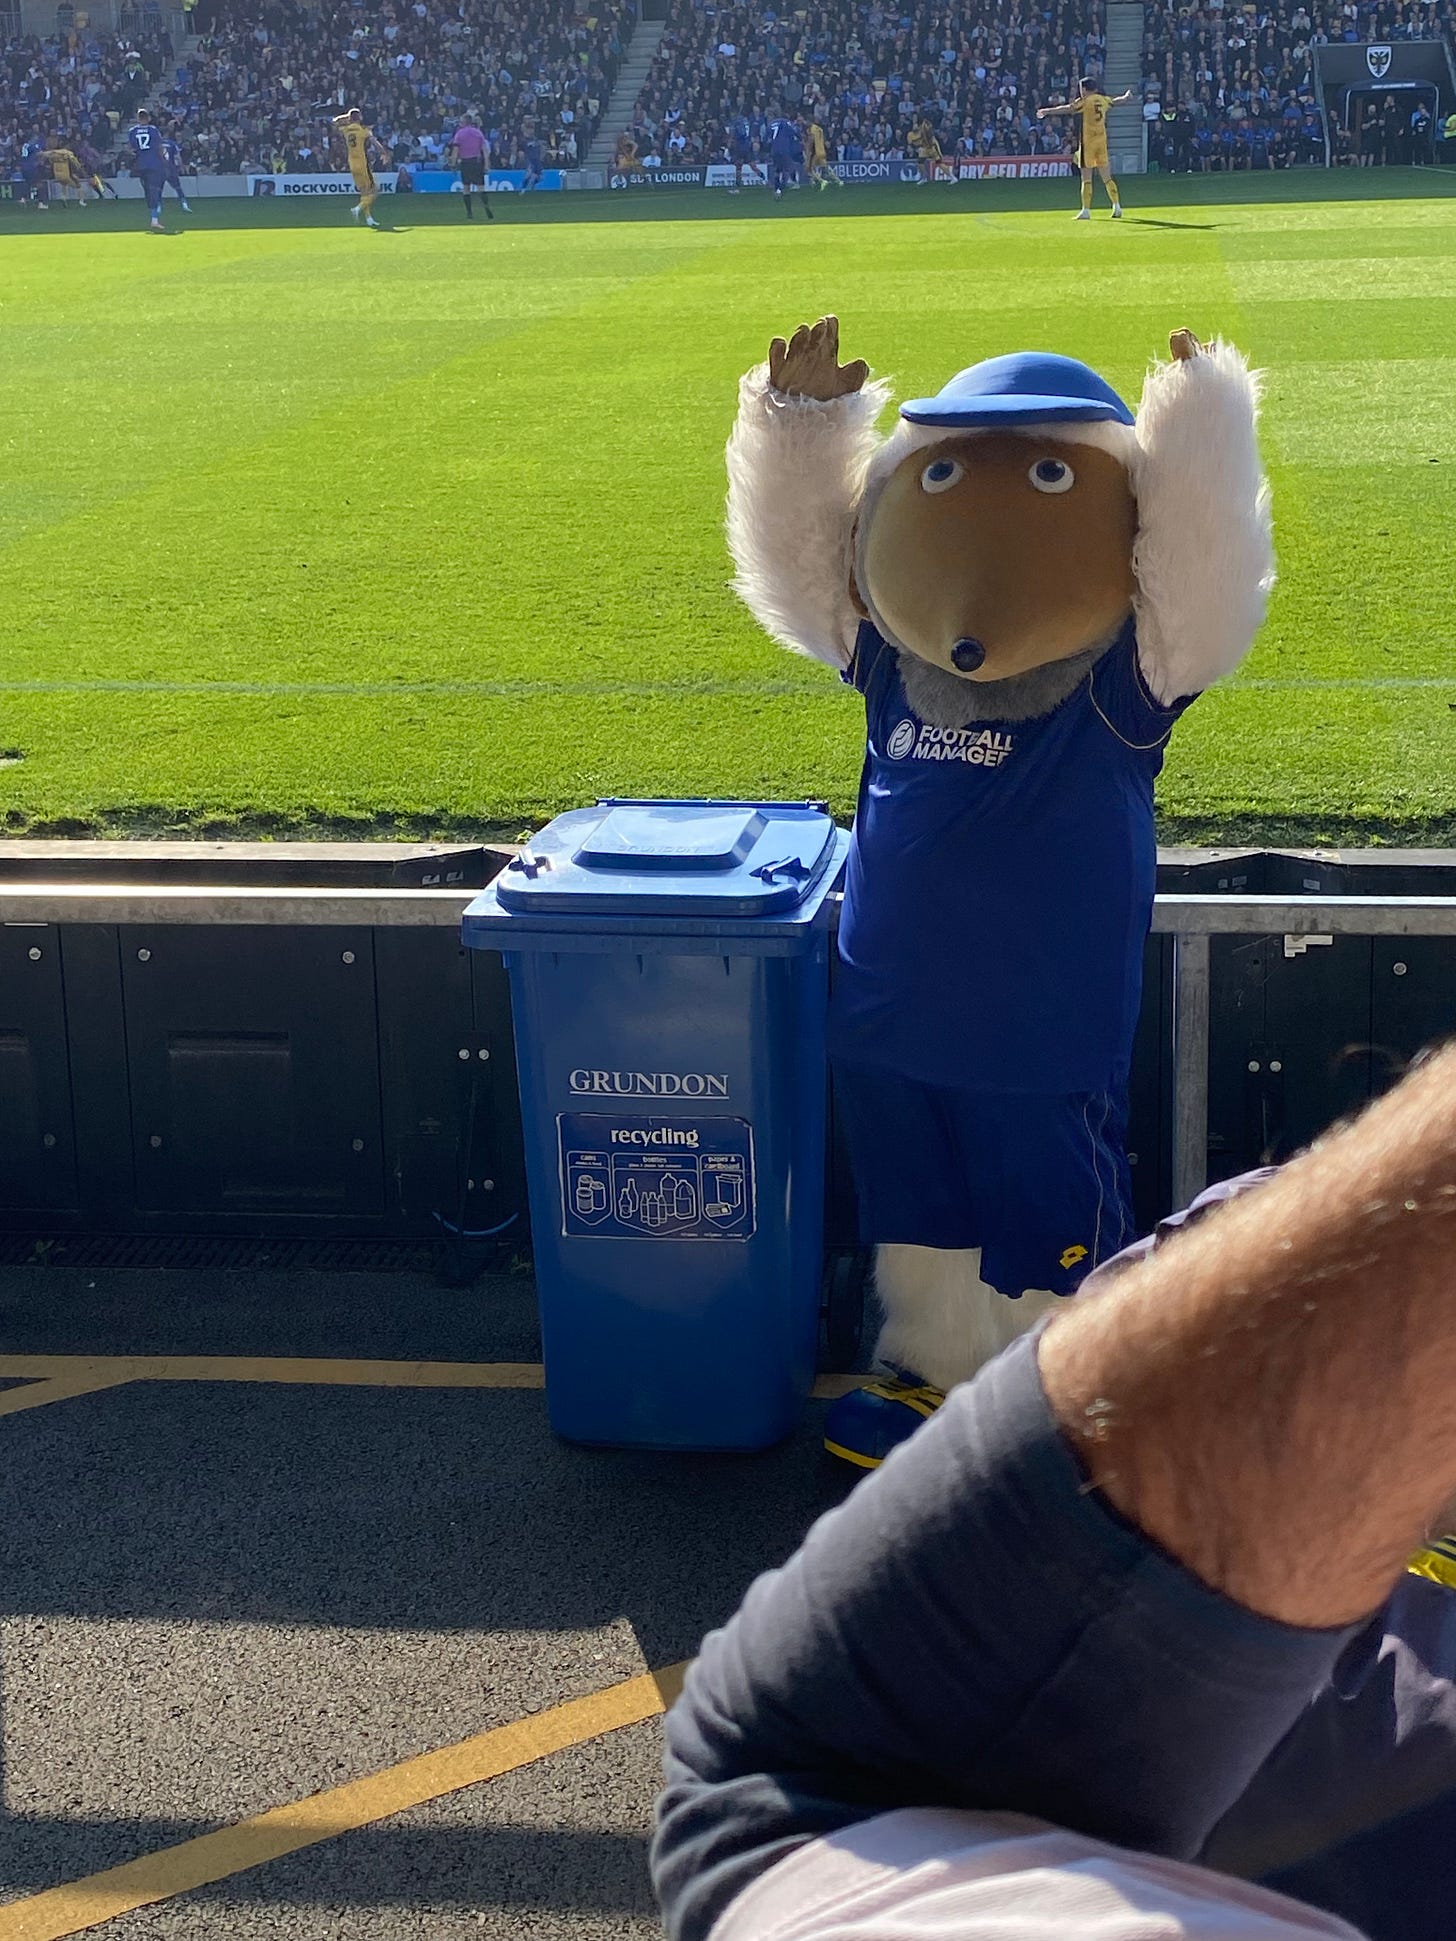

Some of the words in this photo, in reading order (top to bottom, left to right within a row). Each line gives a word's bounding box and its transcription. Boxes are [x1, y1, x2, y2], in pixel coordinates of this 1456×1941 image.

[1094, 104, 1103, 121] 5
[771, 126, 779, 140] 7
[136, 134, 150, 149] 12
[655, 172, 700, 183] LONDON
[815, 164, 889, 177] MBLEDON
[989, 163, 1017, 178] RED
[919, 725, 1013, 751] FOOTBALL
[569, 1069, 729, 1095] GRUNDON
[611, 1127, 699, 1148] recycling
